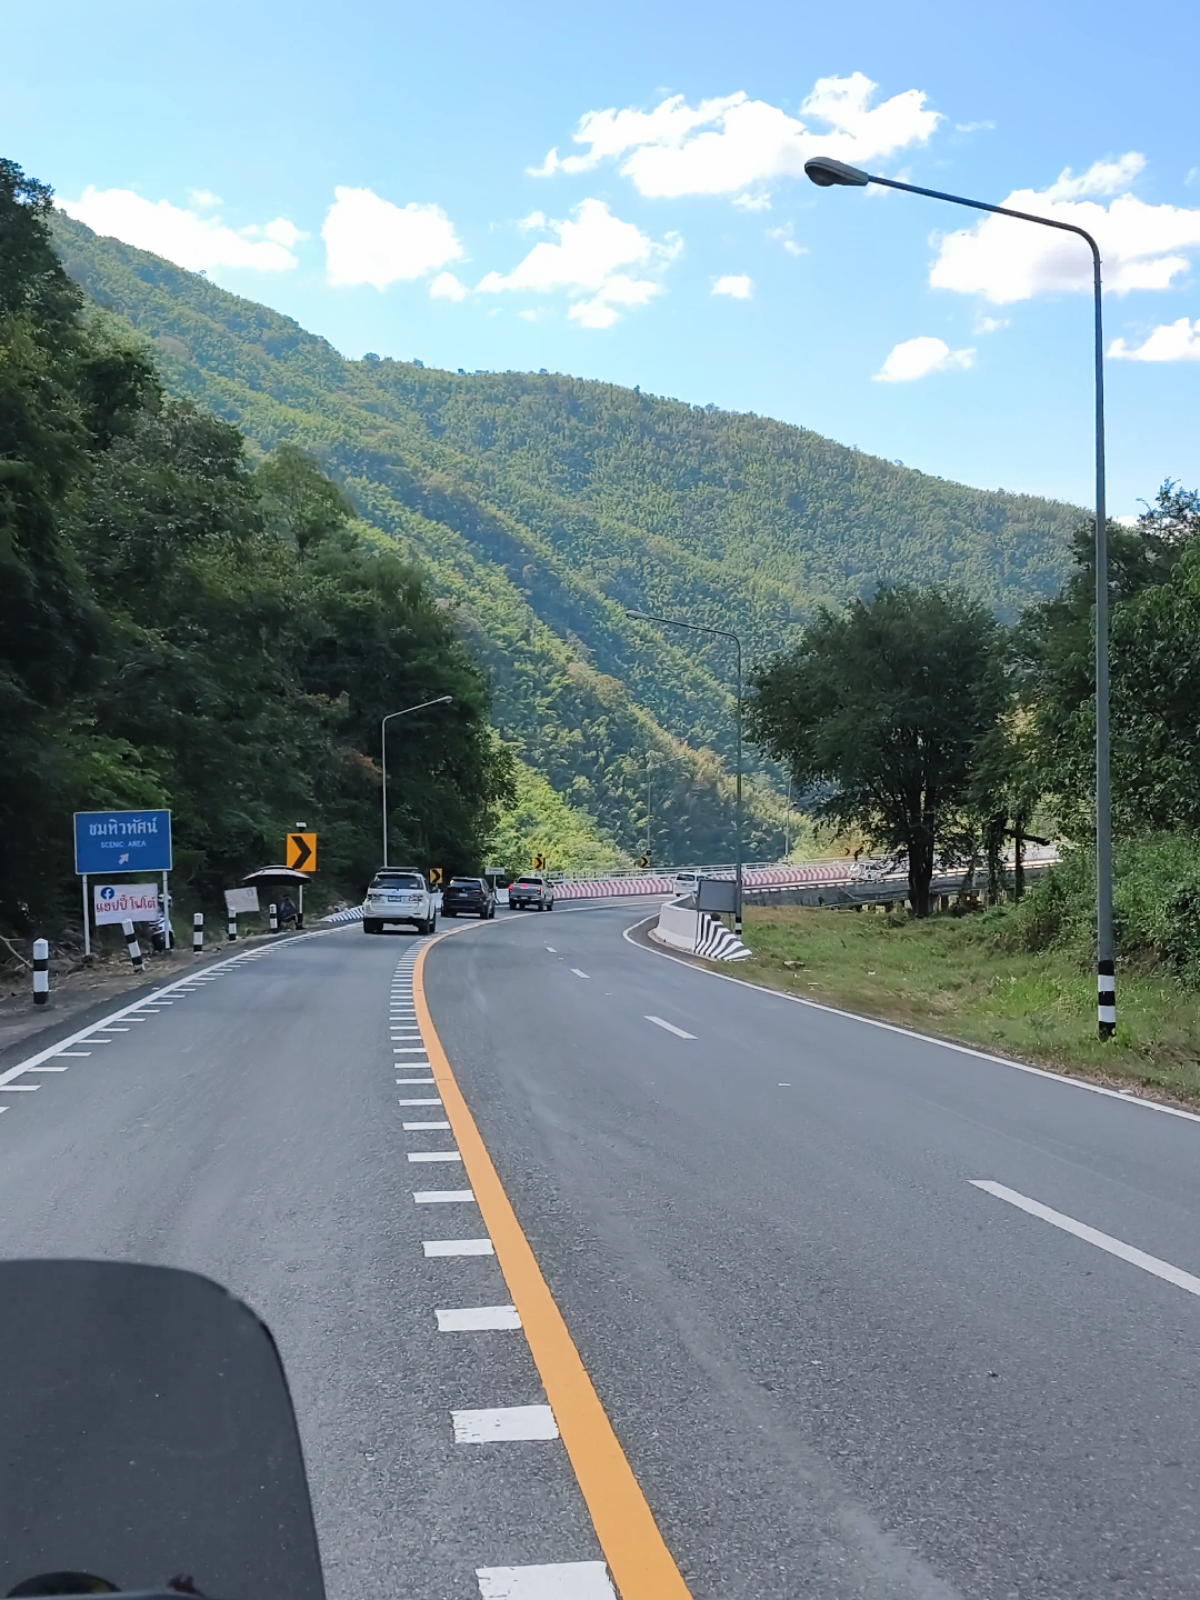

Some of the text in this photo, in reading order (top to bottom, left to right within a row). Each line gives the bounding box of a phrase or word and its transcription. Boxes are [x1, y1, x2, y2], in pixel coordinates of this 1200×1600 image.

[89, 817, 158, 836] ชมทิวทัศน์
[100, 840, 147, 849] SCENIC AREA
